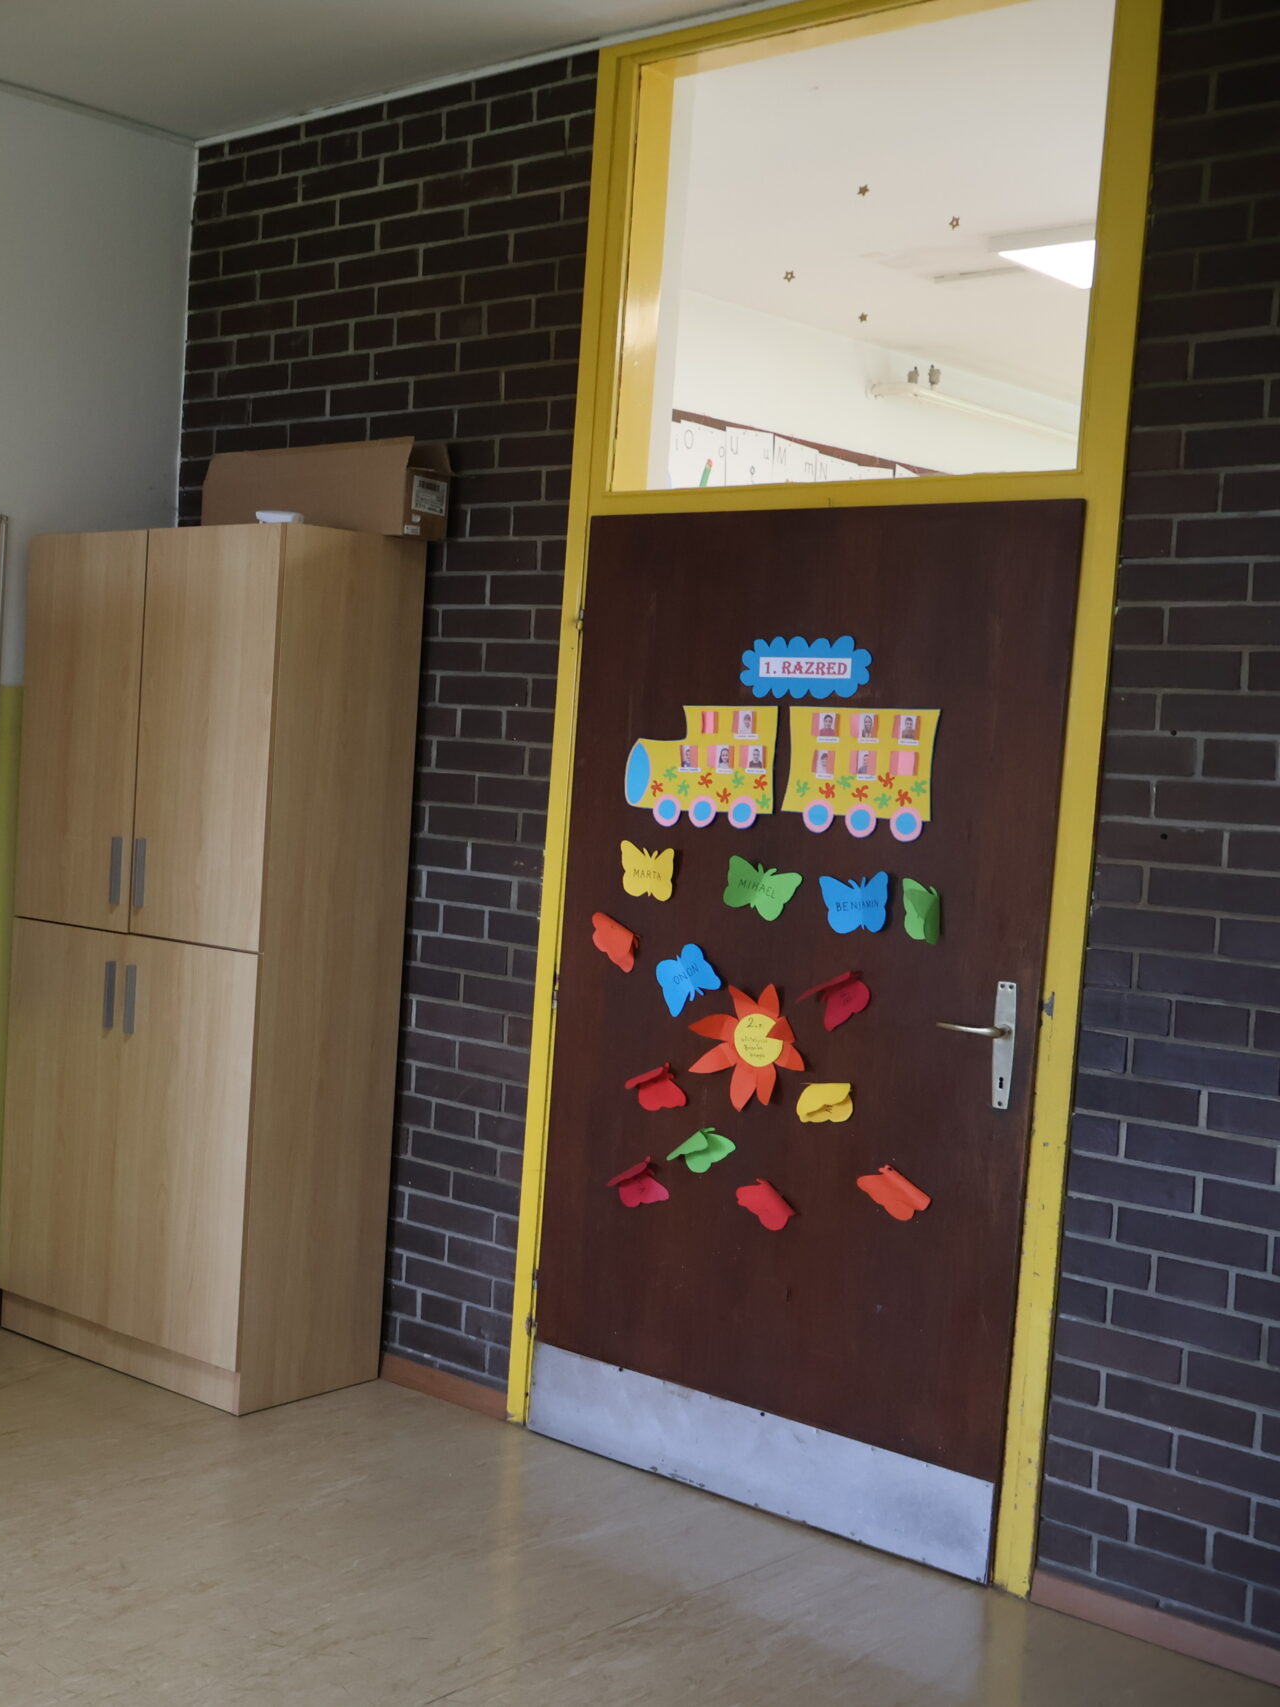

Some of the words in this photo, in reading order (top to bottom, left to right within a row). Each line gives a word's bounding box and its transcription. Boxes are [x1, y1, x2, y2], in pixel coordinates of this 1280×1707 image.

[764, 661, 776, 675] 1.
[781, 661, 848, 676] RAZRED
[633, 868, 662, 881] MARTA
[737, 878, 777, 899] MIHAEL
[835, 898, 879, 912] BENJAMIN
